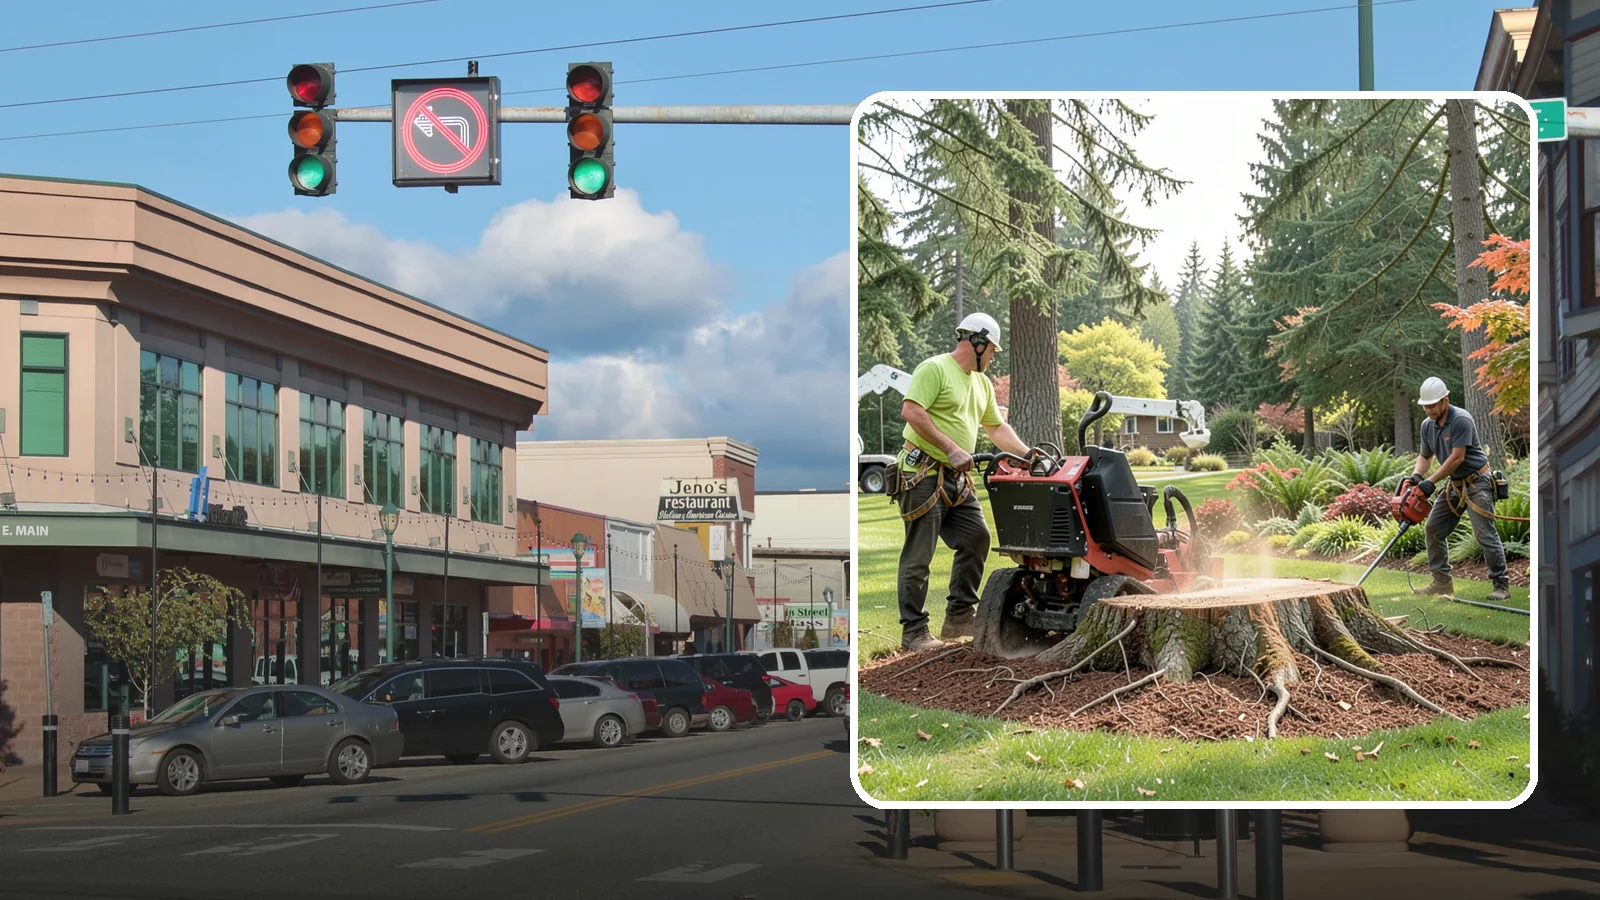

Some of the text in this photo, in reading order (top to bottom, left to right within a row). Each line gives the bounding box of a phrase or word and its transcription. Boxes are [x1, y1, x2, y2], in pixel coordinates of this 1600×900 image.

[670, 479, 727, 495] Jeno's
[665, 496, 731, 509] restaurant
[658, 509, 681, 519] Italian
[685, 509, 714, 519] American
[715, 509, 737, 519] Cuisine
[2, 525, 49, 536] E. MAIN
[797, 607, 829, 617] Street
